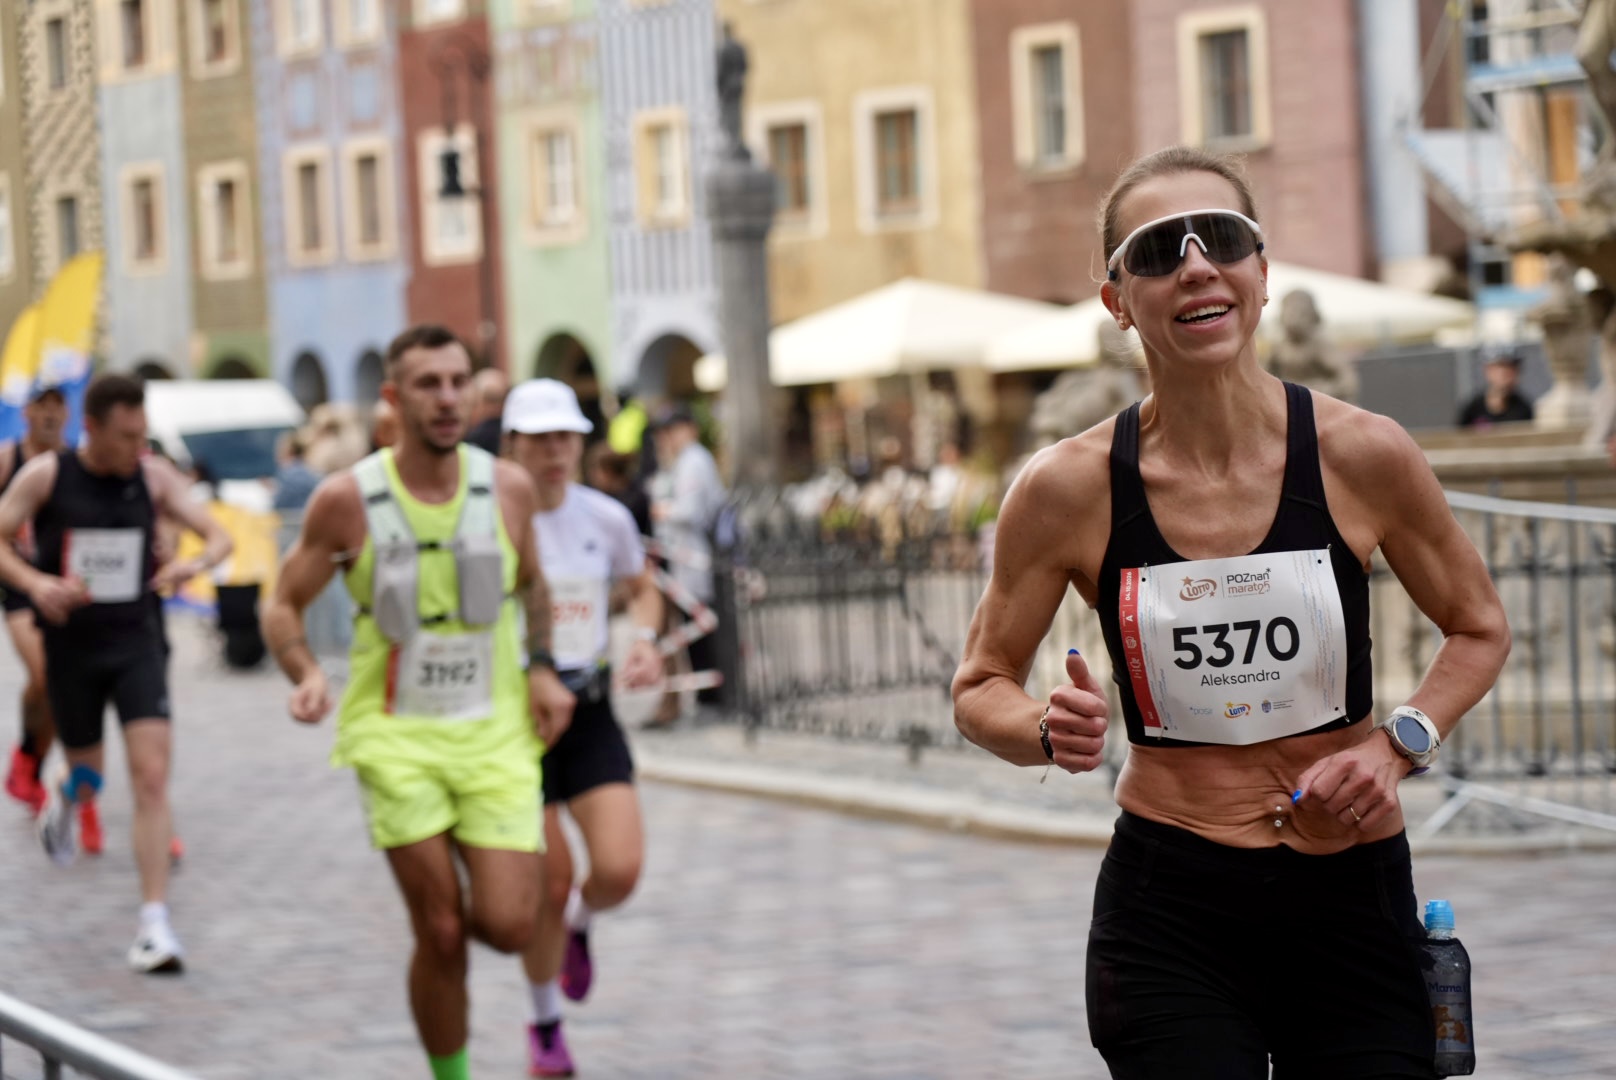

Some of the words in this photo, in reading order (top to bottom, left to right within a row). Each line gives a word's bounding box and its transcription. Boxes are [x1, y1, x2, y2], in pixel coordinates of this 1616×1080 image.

[1186, 582, 1210, 597] LOTTO
[1125, 614, 1133, 622] A
[1173, 616, 1300, 670] 5370
[1200, 669, 1281, 687] Aleksandra
[1228, 705, 1247, 716] LOTTO
